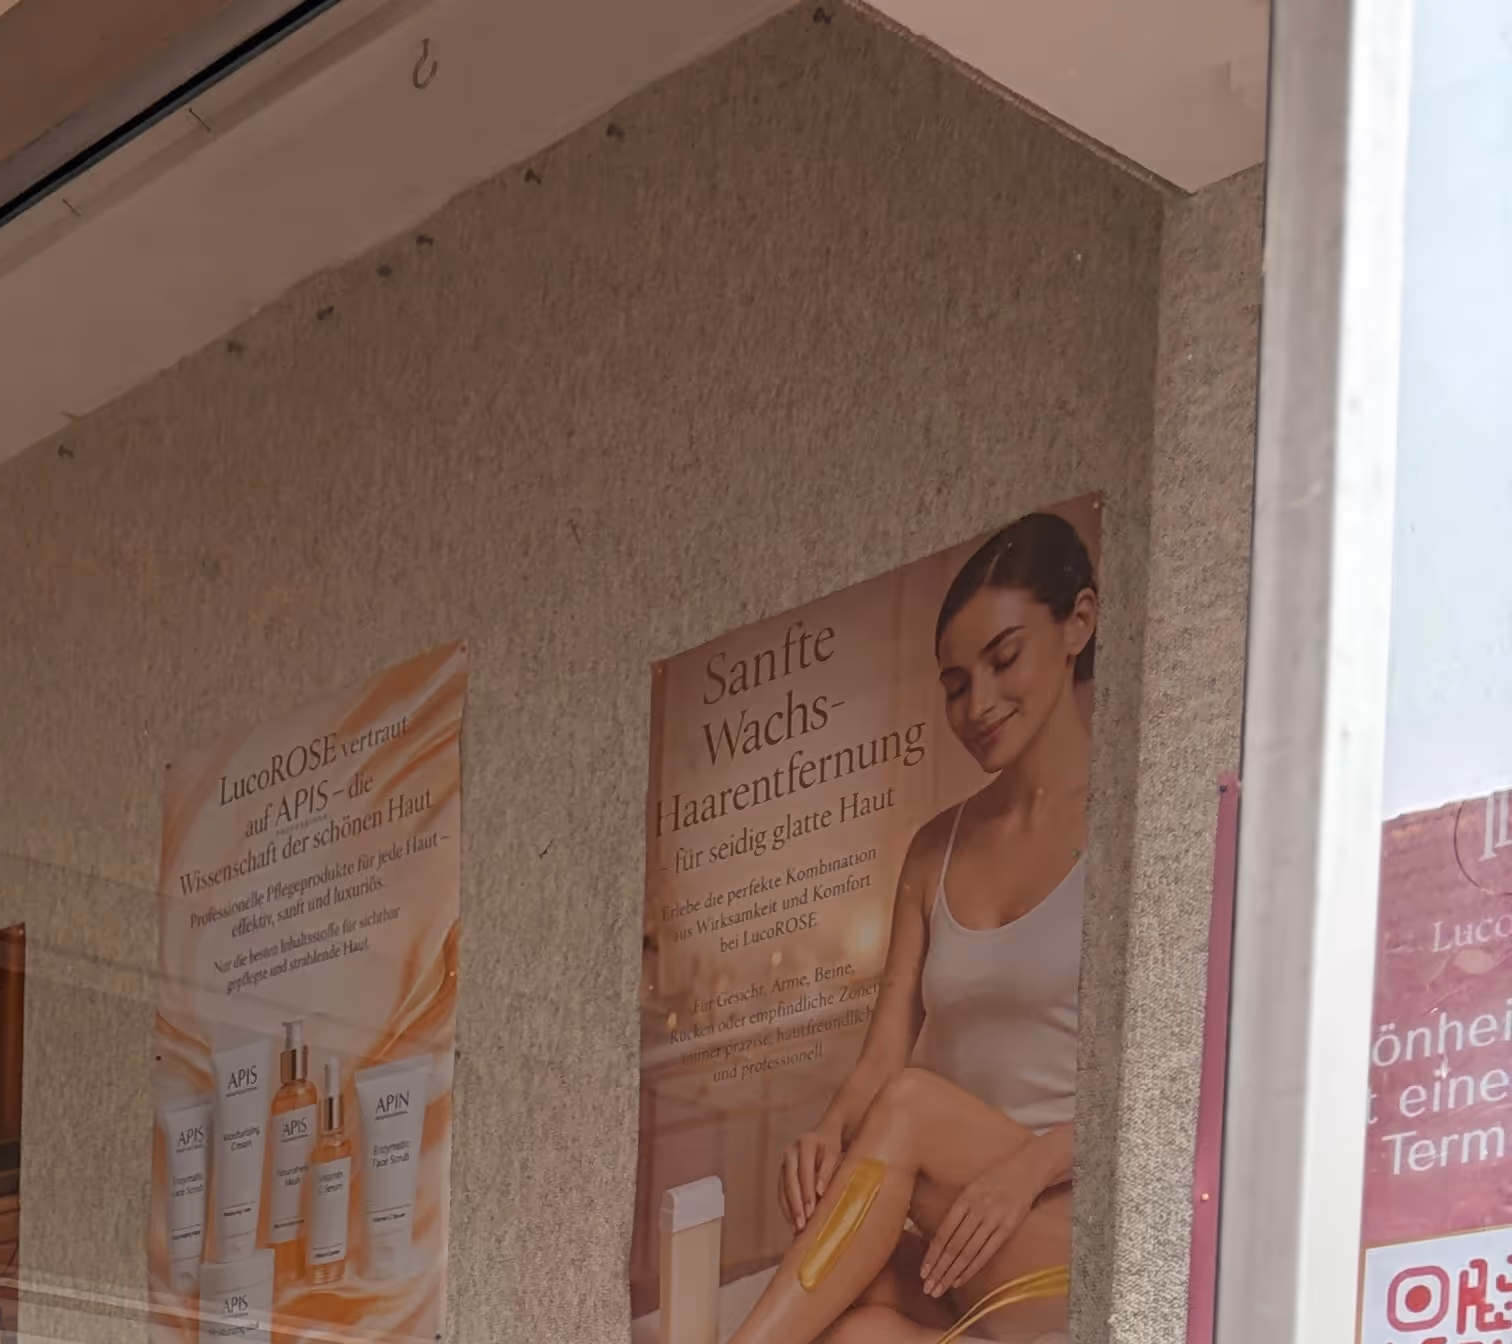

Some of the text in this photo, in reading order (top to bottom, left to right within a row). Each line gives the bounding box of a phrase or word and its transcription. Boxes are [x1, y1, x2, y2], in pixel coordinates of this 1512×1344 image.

[703, 620, 836, 705] Sanfte
[219, 715, 409, 806] LucoROSE vertraut
[702, 689, 846, 767] Wachs-
[244, 802, 274, 838] auf
[275, 779, 329, 828] APIS
[348, 771, 374, 799] die
[655, 721, 927, 838] Haarentfernung
[179, 840, 278, 896] Wissenschaft
[282, 834, 310, 860] der
[313, 815, 383, 849] schönen
[387, 788, 434, 823] Haut
[675, 786, 897, 874] für seidig glatte Haut
[190, 832, 438, 929] Professionelle Pflegeprodukte für jede Haut
[277, 900, 305, 922] sanft
[307, 892, 331, 913] und
[662, 847, 878, 923] Erlebe die perfekte Kombination
[695, 873, 873, 936] Wirksamkeit und Komfort
[720, 911, 818, 953] bei LucoROSE
[227, 1064, 258, 1091] APIS
[177, 1125, 205, 1147] APIS
[282, 1116, 308, 1138] APIS
[223, 1293, 249, 1314] APIS
